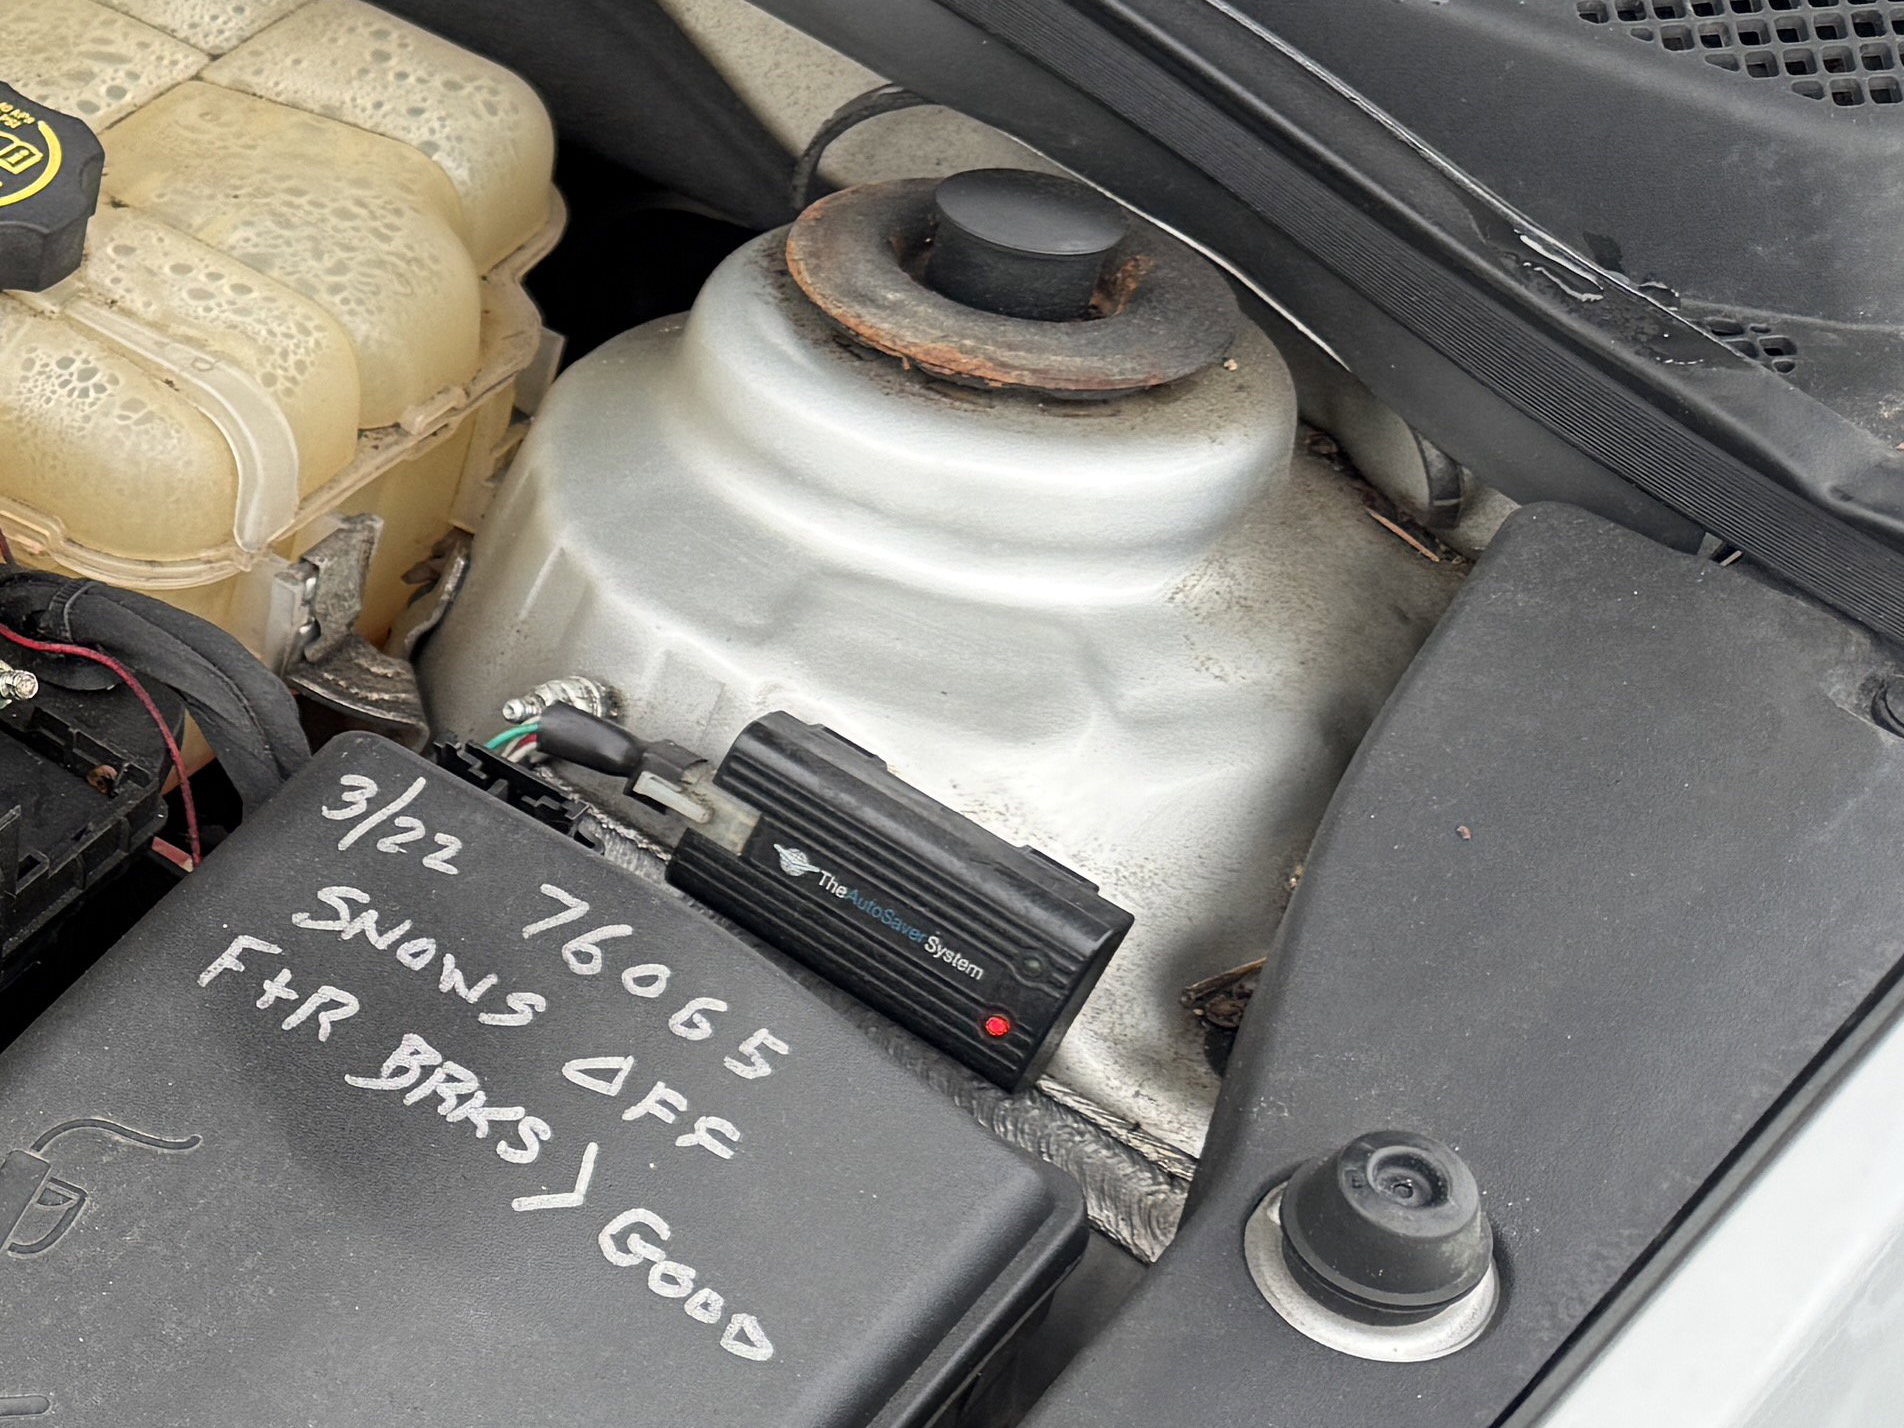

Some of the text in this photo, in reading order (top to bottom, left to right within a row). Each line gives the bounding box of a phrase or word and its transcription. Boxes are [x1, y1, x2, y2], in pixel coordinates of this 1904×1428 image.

[314, 773, 468, 878] 3/22
[290, 884, 549, 1030] SNOWS
[197, 933, 778, 1362] F+R BRKS GOOD
